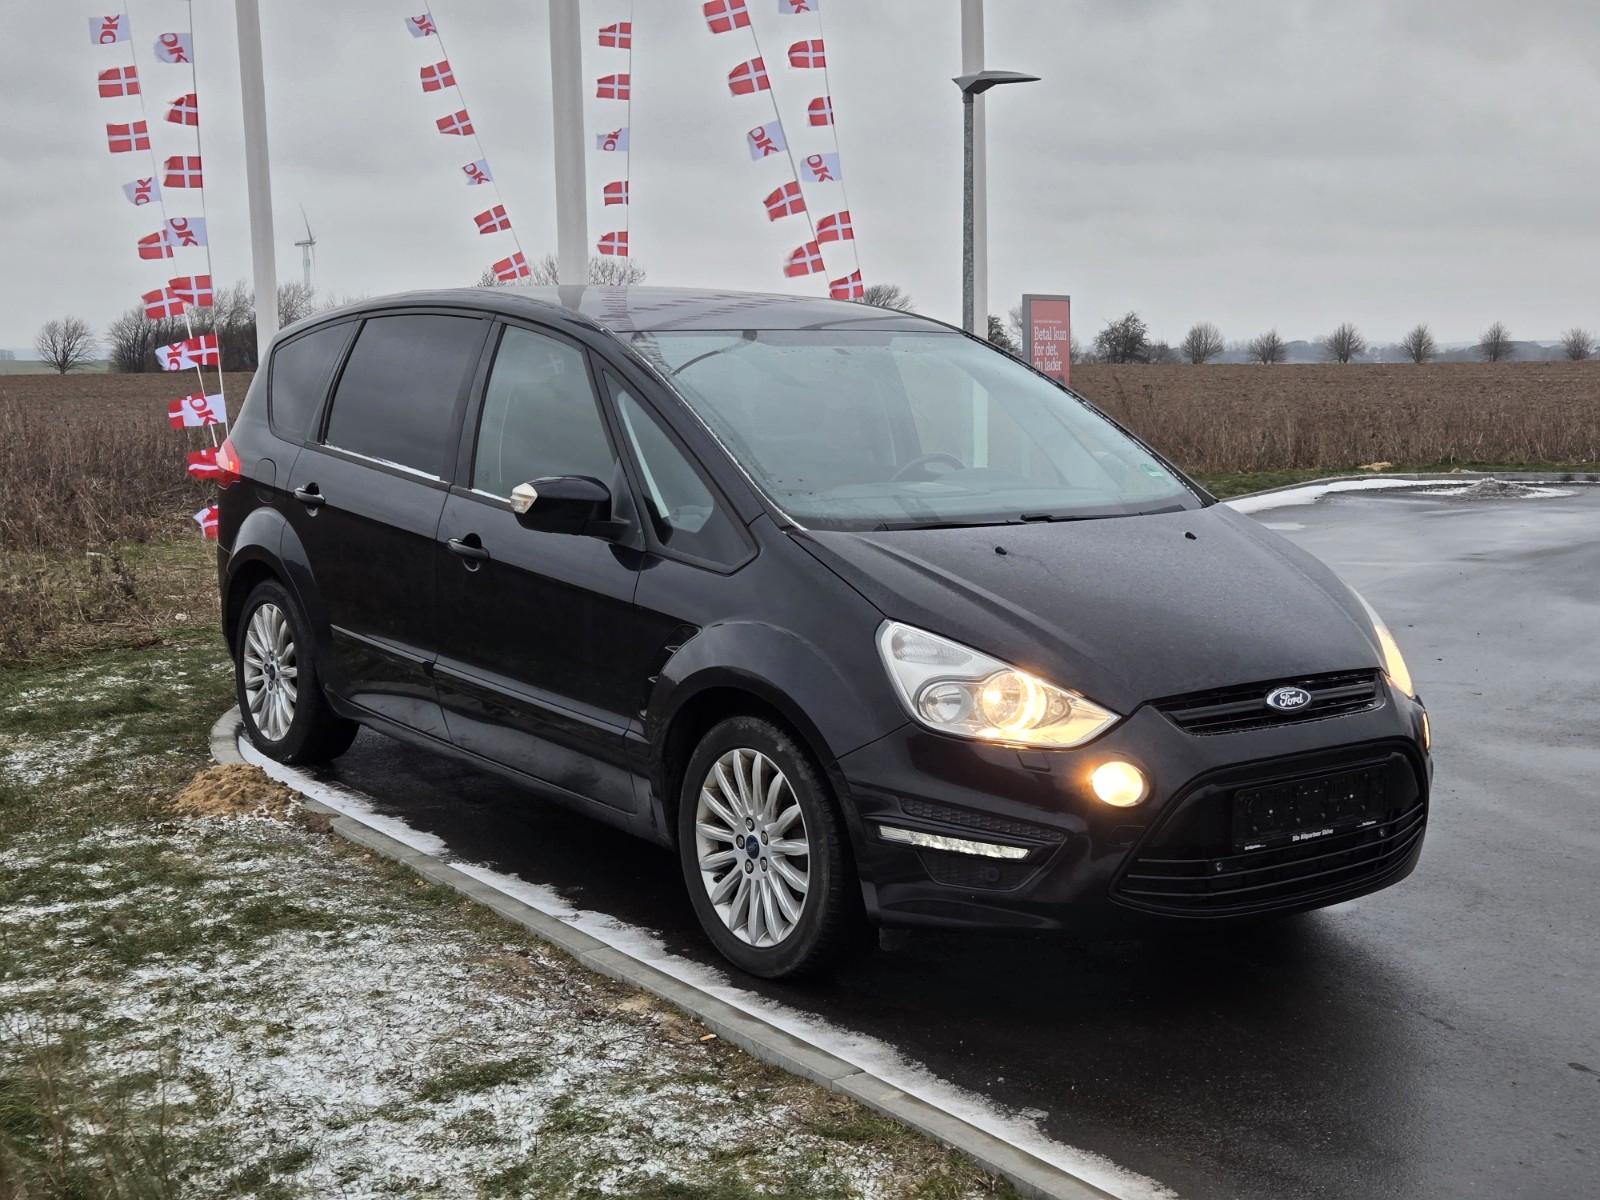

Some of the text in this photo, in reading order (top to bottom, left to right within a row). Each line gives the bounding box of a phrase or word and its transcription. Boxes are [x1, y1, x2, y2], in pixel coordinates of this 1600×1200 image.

[160, 33, 189, 63] OK
[749, 126, 779, 156] OK
[463, 162, 490, 185] OK
[807, 154, 834, 182] OK
[169, 217, 198, 247] OK
[1034, 326, 1067, 341] Betal kun
[1034, 342, 1044, 357] for
[1044, 357, 1063, 371] lader
[189, 397, 219, 426] OK
[1280, 691, 1304, 707] Ford
